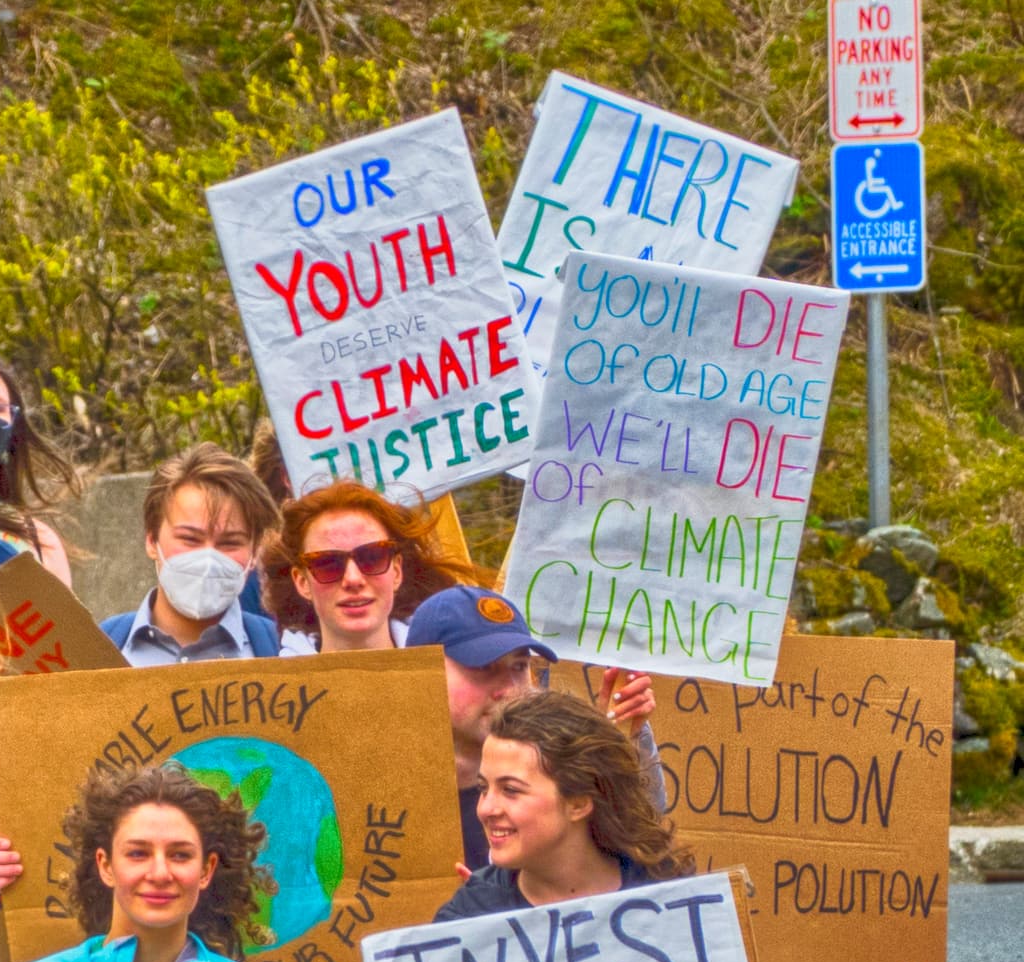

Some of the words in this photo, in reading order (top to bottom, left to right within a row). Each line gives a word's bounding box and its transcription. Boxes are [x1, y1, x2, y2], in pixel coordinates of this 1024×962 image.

[837, 36, 913, 65] PARKING
[858, 5, 891, 32] NO
[855, 89, 897, 109] TIME
[859, 67, 893, 86] ANY
[293, 157, 396, 228] OUR
[551, 83, 772, 251] THERE
[841, 220, 917, 240] ACCESSIBLE
[841, 237, 916, 258] ENTRANCE
[255, 215, 457, 337] YOUTH
[320, 314, 427, 364] DESERVE
[733, 288, 838, 365] DIE
[294, 315, 519, 439] CLIMATE
[644, 353, 728, 401] OLD
[739, 367, 827, 421] AGE
[309, 388, 529, 492] JUSTICE
[563, 400, 698, 476] WE'LL
[715, 418, 813, 502] DIE
[590, 498, 803, 600] CLIMATE
[524, 560, 781, 681] CHANGE
[170, 679, 329, 733] ENERGY
[675, 677, 709, 715] a
[732, 668, 828, 733] part
[831, 674, 888, 728] of
[886, 686, 945, 757] the
[656, 742, 903, 829] SOLUTION
[328, 803, 408, 948] FUTURE
[774, 860, 939, 919] POLUTION
